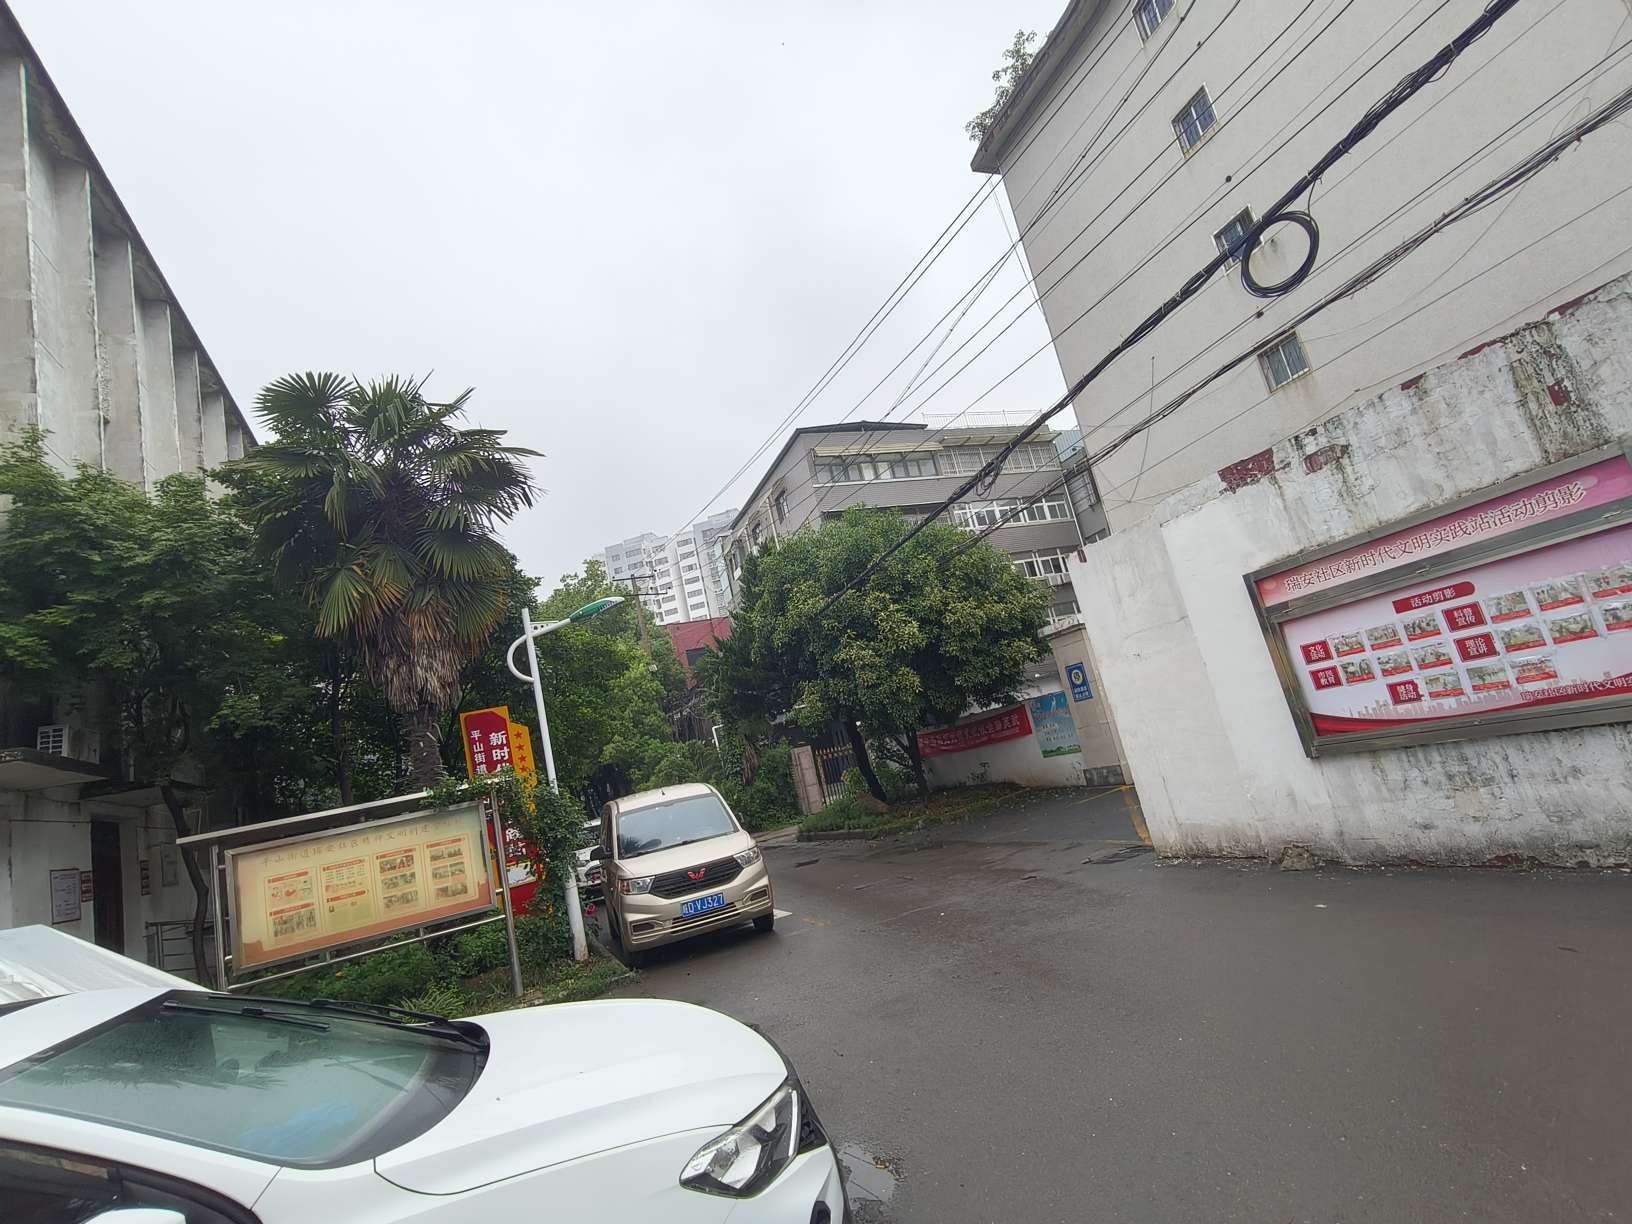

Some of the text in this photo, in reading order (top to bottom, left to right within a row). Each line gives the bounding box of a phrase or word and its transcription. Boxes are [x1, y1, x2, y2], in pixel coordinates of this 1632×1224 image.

[1285, 481, 1586, 592] 瑞安社区新时代文明实践站活动剪影
[1410, 587, 1456, 608] 活动剪影
